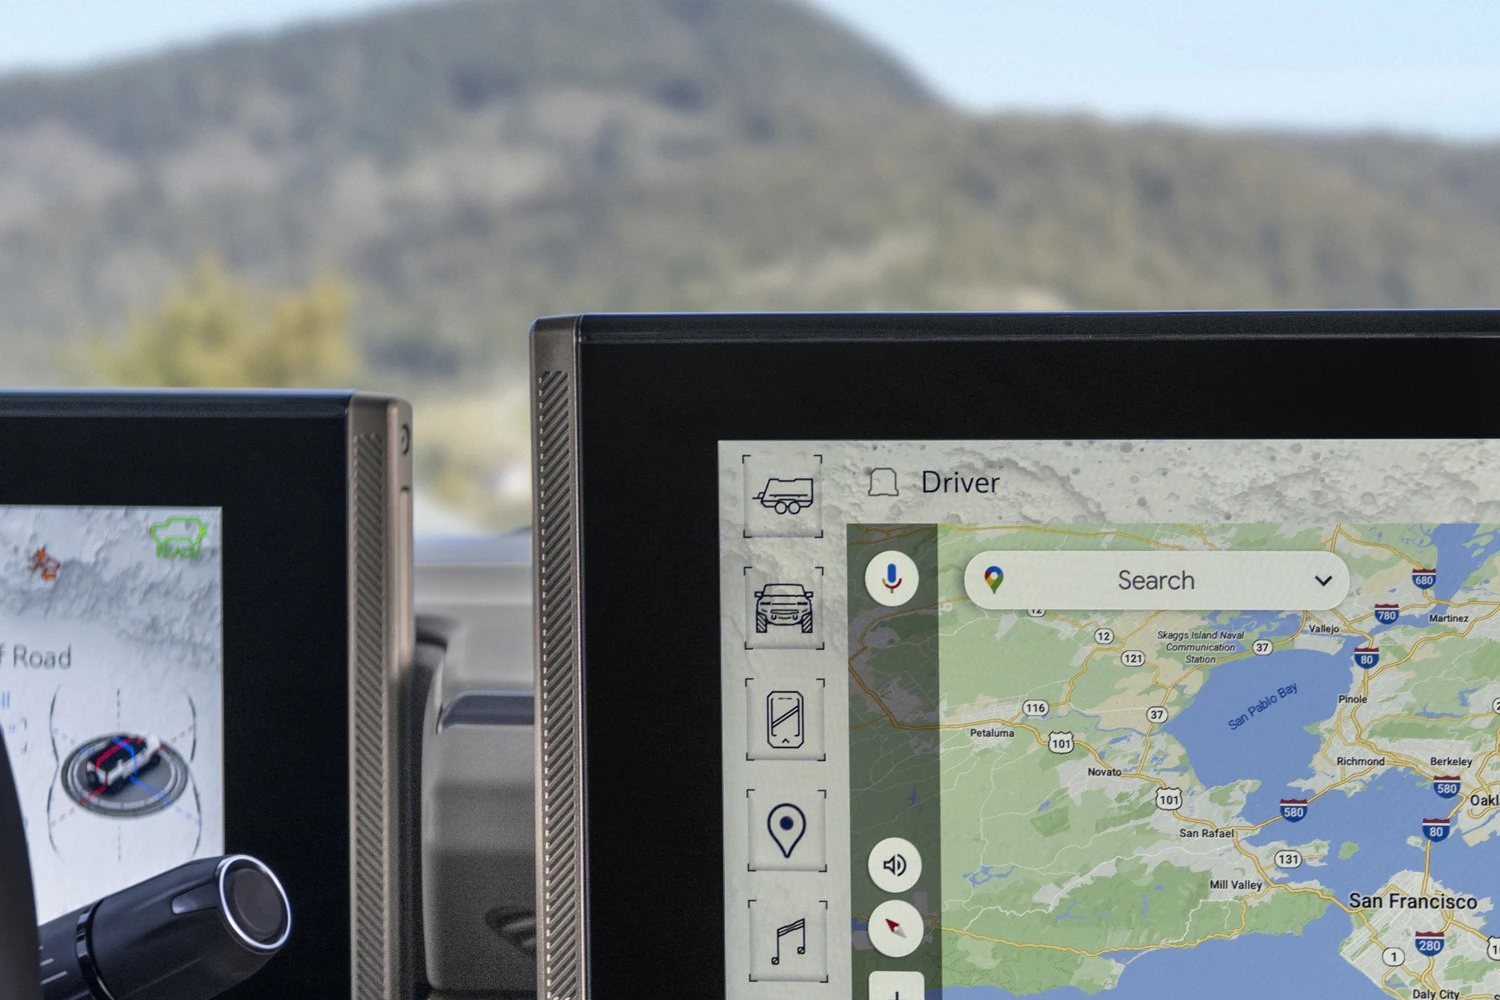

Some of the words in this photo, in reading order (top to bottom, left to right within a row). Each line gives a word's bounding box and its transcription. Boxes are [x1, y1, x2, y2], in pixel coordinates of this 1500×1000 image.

[922, 471, 1000, 493] Driver
[1119, 571, 1195, 591] Search
[1416, 576, 1433, 585] 680
[1378, 611, 1396, 620] 780
[1429, 613, 1469, 623] Martinez
[1309, 624, 1339, 634] Vallejo
[1097, 631, 1111, 641] 12
[1157, 630, 1189, 641] Skaggs
[1191, 631, 1218, 640] Island
[1220, 631, 1245, 640] Naval
[1166, 643, 1236, 652] Communication
[1256, 643, 1268, 652] 37
[13, 645, 71, 669] Road
[1124, 653, 1142, 664] 121
[1185, 655, 1216, 664] Station
[1360, 654, 1373, 664] 80
[1339, 695, 1367, 704] Pinole
[1026, 703, 1045, 713] 116
[1228, 714, 1249, 731] San
[1248, 694, 1278, 717] Pablo
[1277, 682, 1298, 700] Bay
[1150, 709, 1164, 719] 37
[970, 729, 1014, 738] Petaluma
[1052, 740, 1071, 749] 101
[1337, 757, 1385, 766] Richmond
[1431, 757, 1472, 768] Berkeley
[1088, 768, 1121, 777] Novato
[1438, 784, 1456, 794] 580
[1160, 796, 1178, 805] 101
[1284, 808, 1303, 818] 580
[1180, 829, 1199, 838] San
[1202, 829, 1234, 838] Rafael
[1430, 827, 1442, 837] 80
[1279, 855, 1298, 864] 131
[1210, 881, 1229, 890] Mill
[1232, 881, 1262, 892] Valley
[1349, 893, 1382, 908] San
[1390, 894, 1478, 909] Francisco
[1419, 941, 1440, 951] 280
[1391, 952, 1397, 962] 1
